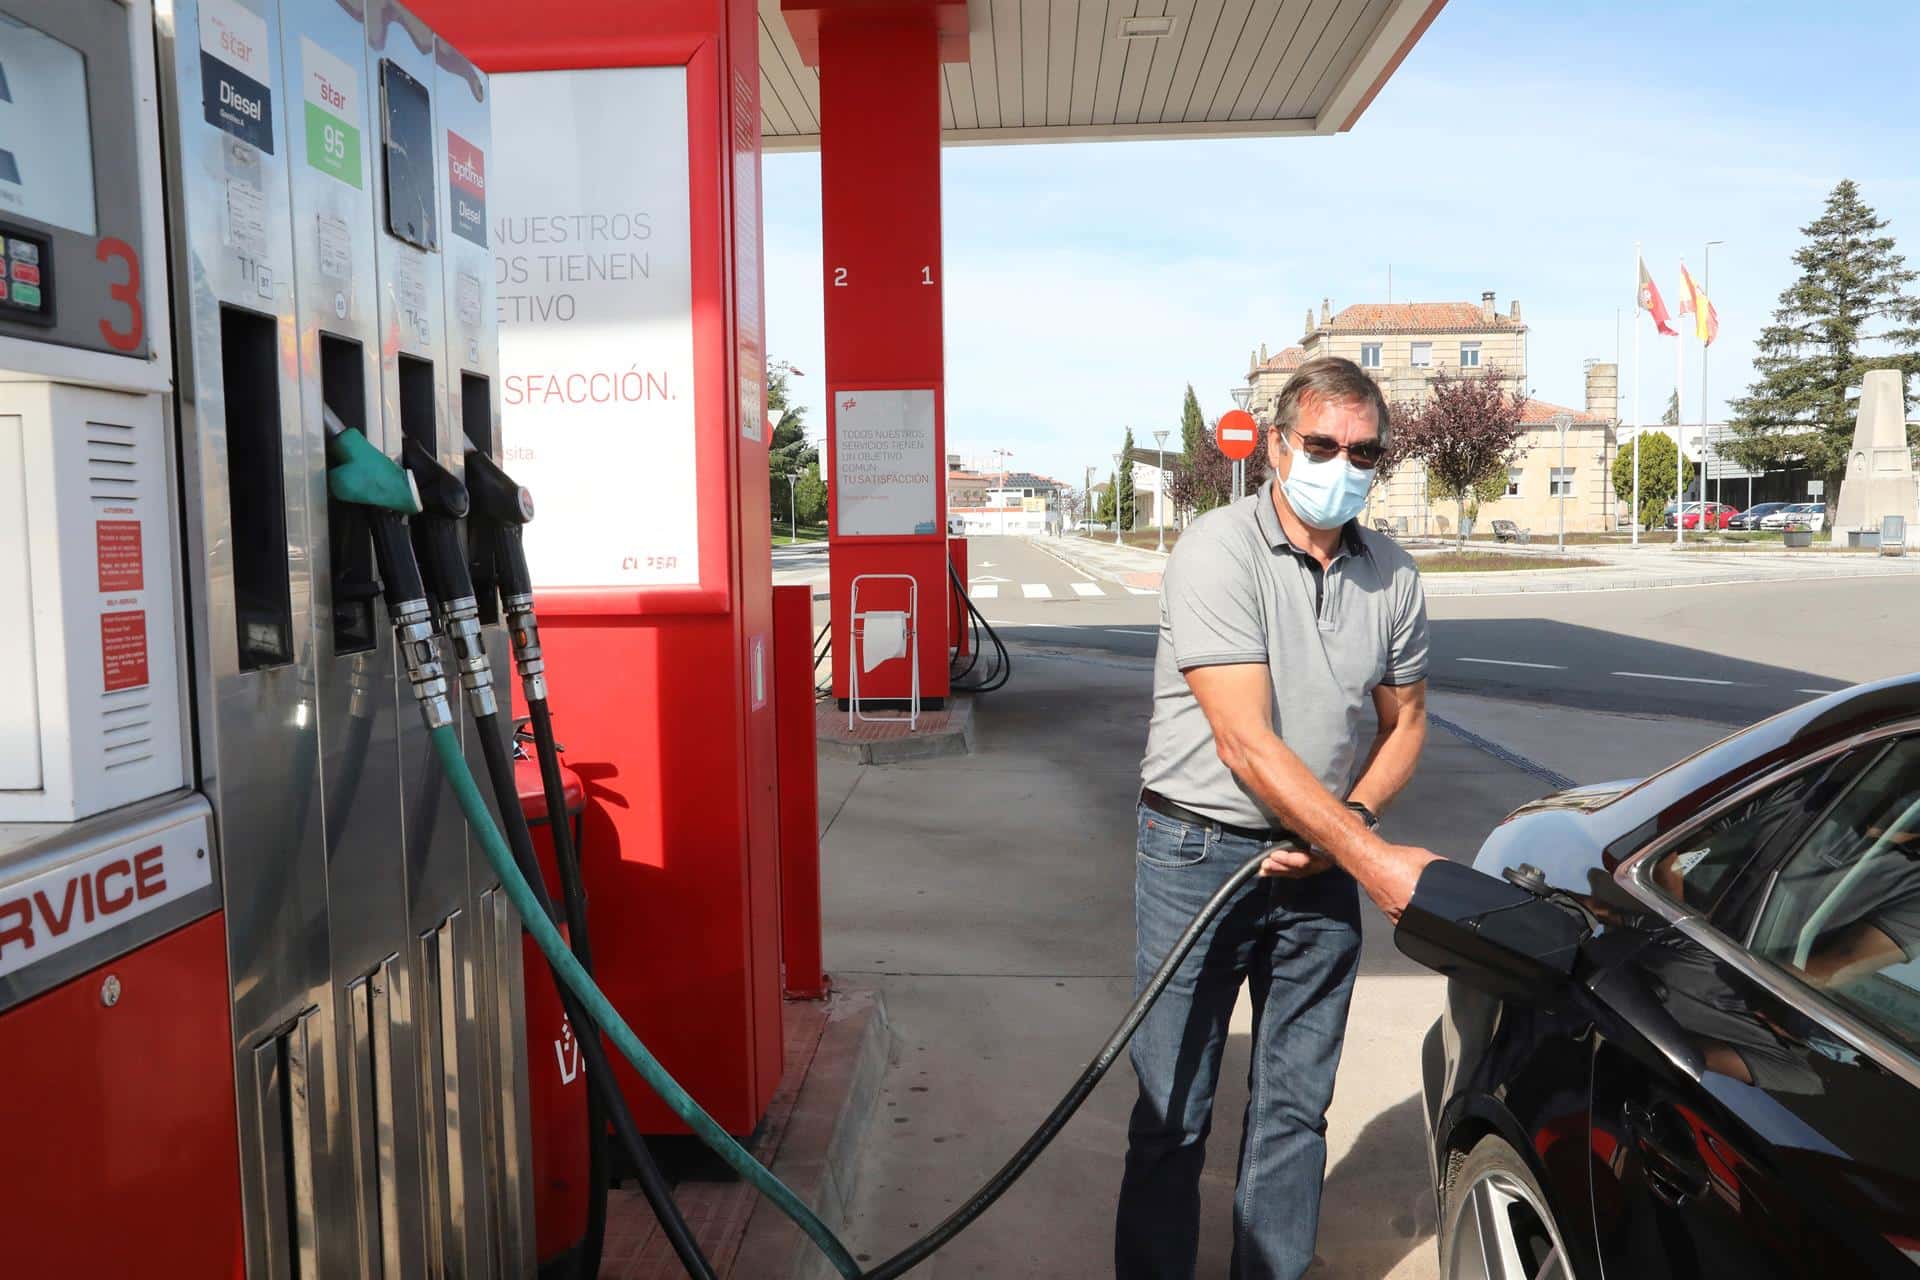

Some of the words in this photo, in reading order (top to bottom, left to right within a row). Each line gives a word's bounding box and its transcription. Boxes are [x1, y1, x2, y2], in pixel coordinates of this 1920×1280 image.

[220, 31, 252, 62] star
[219, 79, 262, 121] Diesel
[320, 82, 346, 110] star
[323, 124, 345, 159] 95
[452, 158, 484, 189] optima
[459, 199, 481, 225] Diesel
[536, 250, 649, 283] TIENEN
[833, 267, 849, 287] 2
[921, 265, 935, 285] 1
[96, 236, 143, 352] 3
[504, 363, 676, 404] SFACCIÓN.
[0, 844, 167, 961] RVICE
